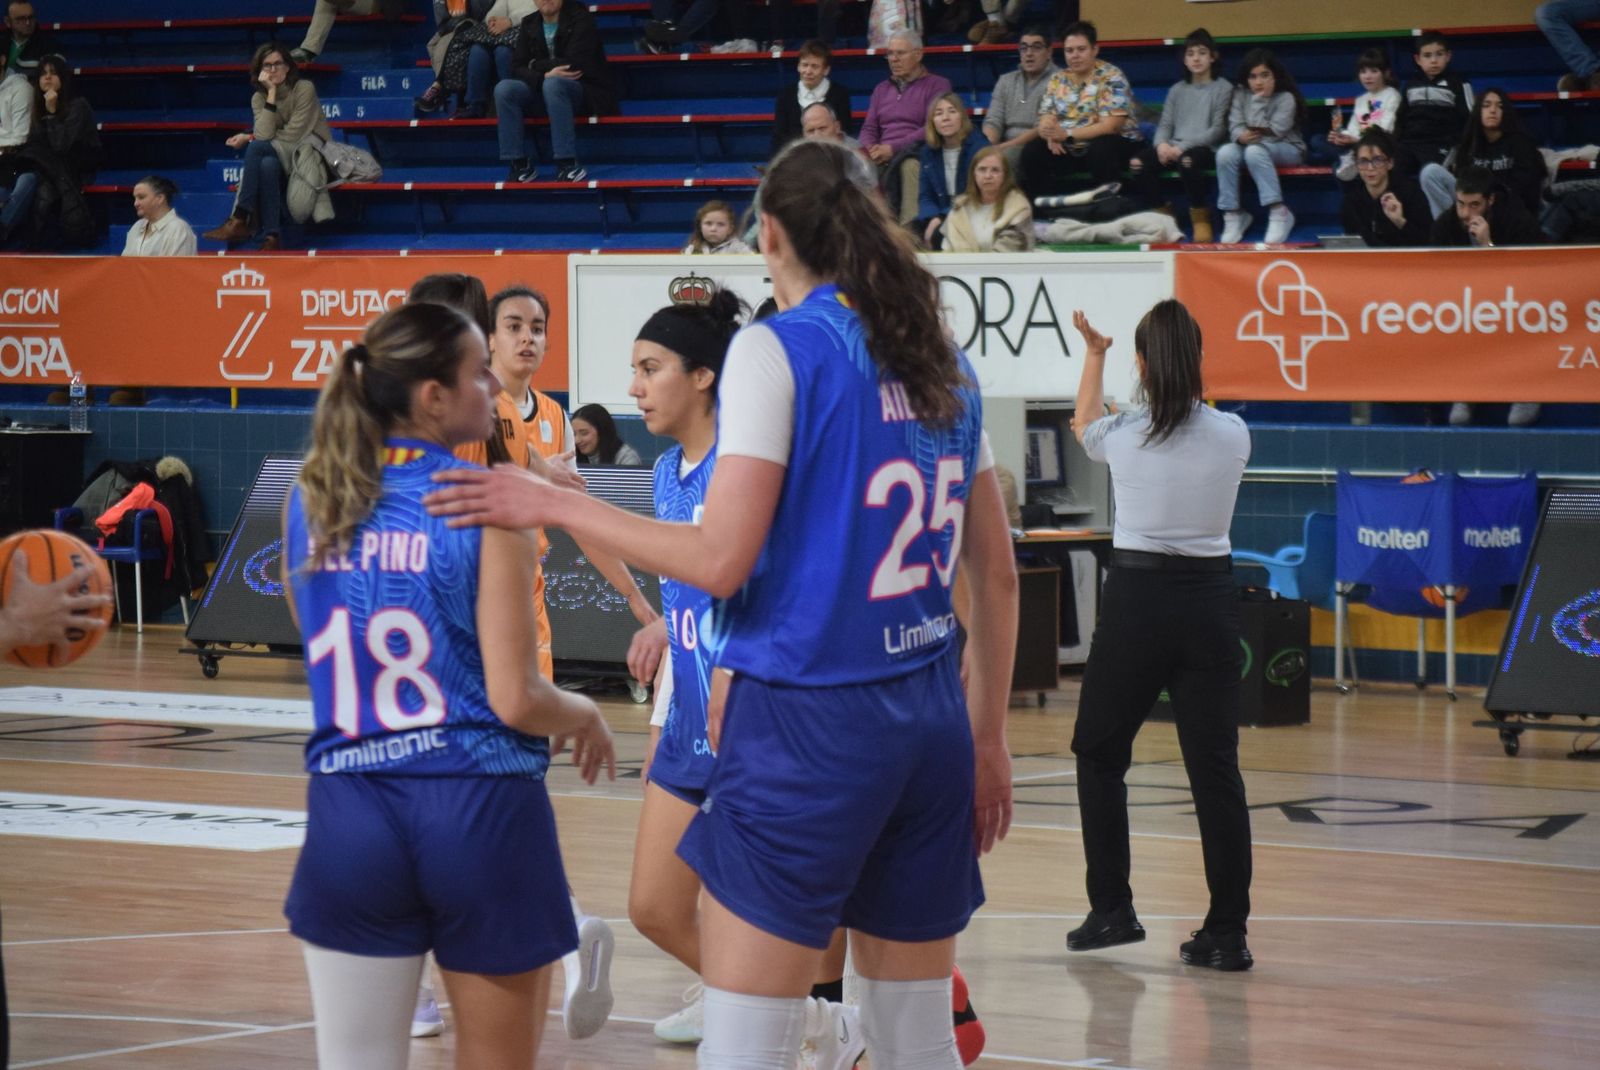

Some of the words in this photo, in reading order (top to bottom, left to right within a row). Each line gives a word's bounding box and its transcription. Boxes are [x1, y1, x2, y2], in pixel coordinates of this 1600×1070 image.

[1361, 286, 1568, 334] recoletas
[864, 456, 965, 600] 25
[1357, 526, 1430, 550] molten
[1463, 526, 1522, 548] molten
[360, 530, 428, 573] PINO
[671, 607, 698, 650] 10
[308, 606, 447, 739] 18
